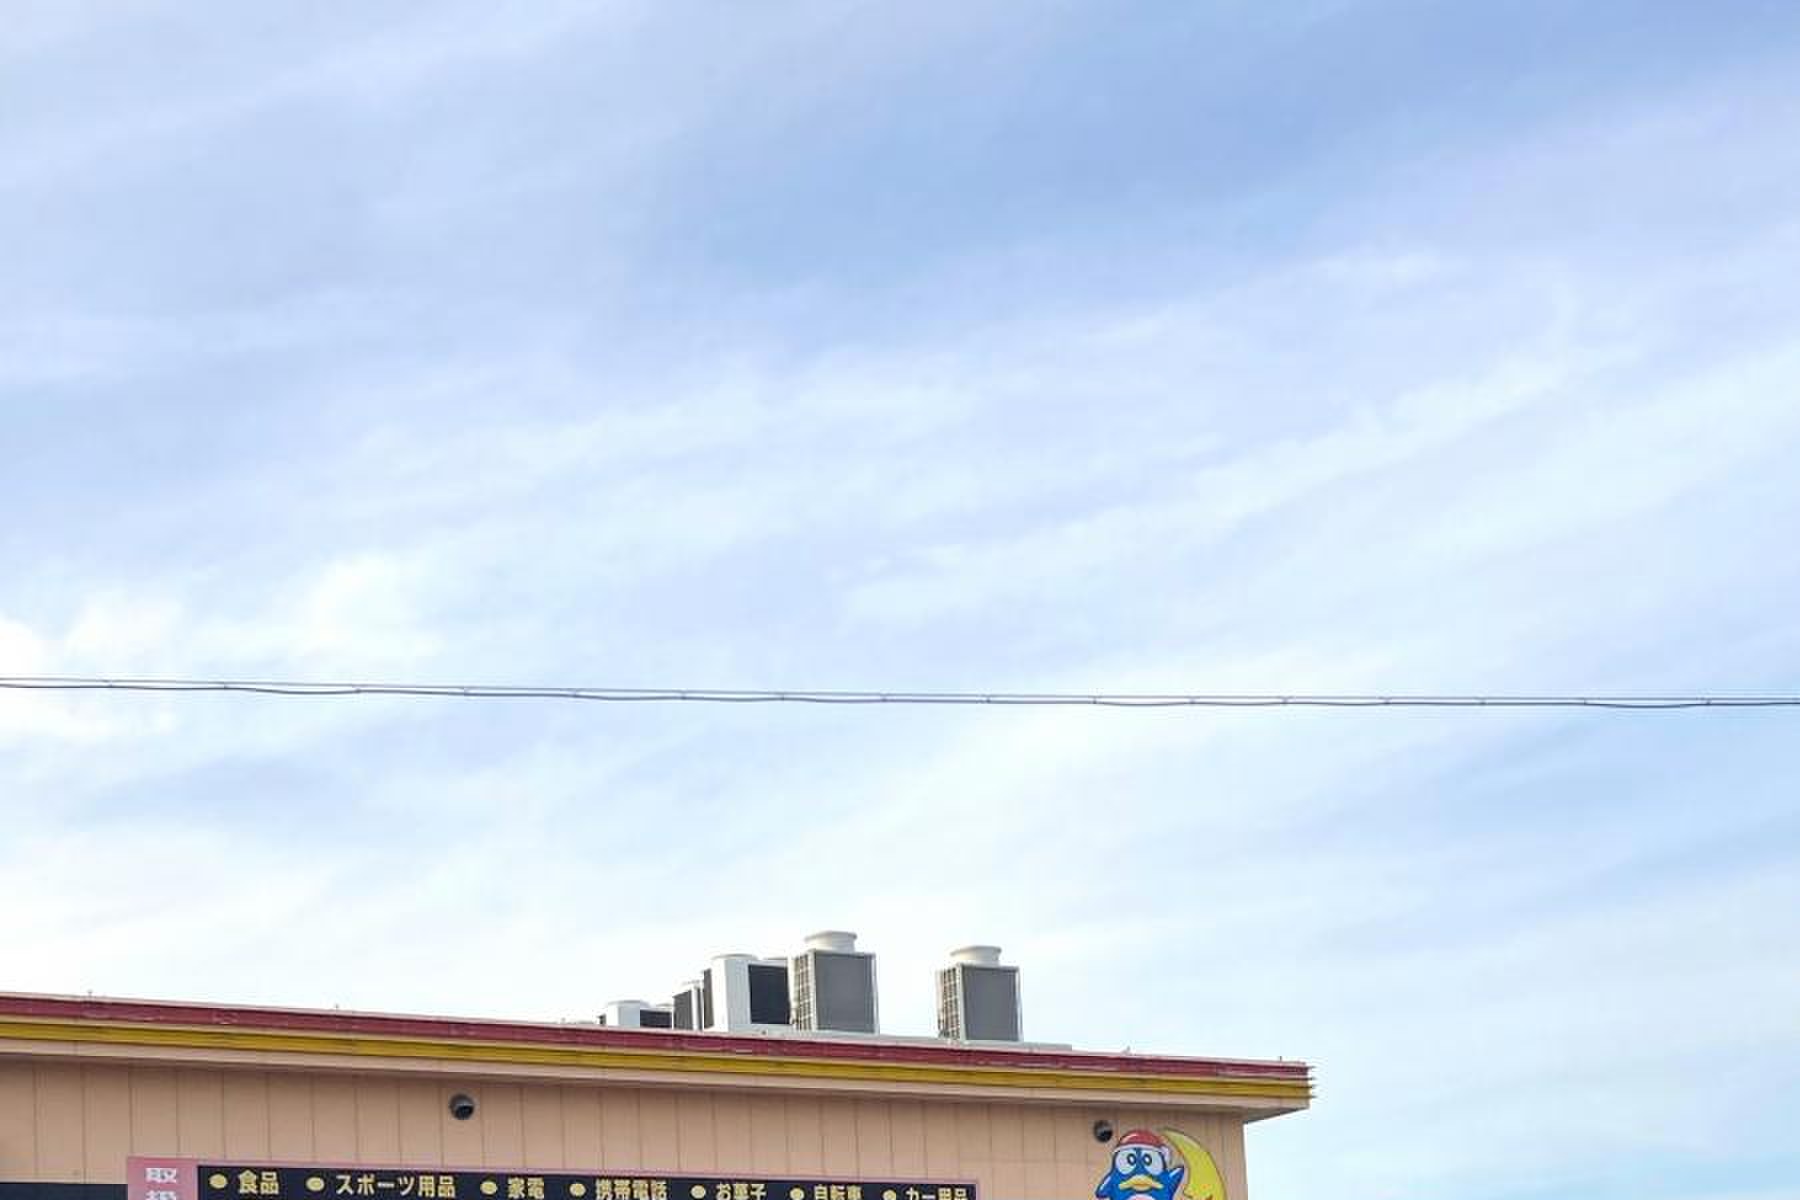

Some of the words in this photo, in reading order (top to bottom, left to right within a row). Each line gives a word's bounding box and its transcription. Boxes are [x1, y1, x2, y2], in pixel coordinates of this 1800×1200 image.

[238, 1171, 280, 1195] 食品
[335, 1173, 456, 1199] スポーツ用品
[507, 1177, 545, 1200] 家電
